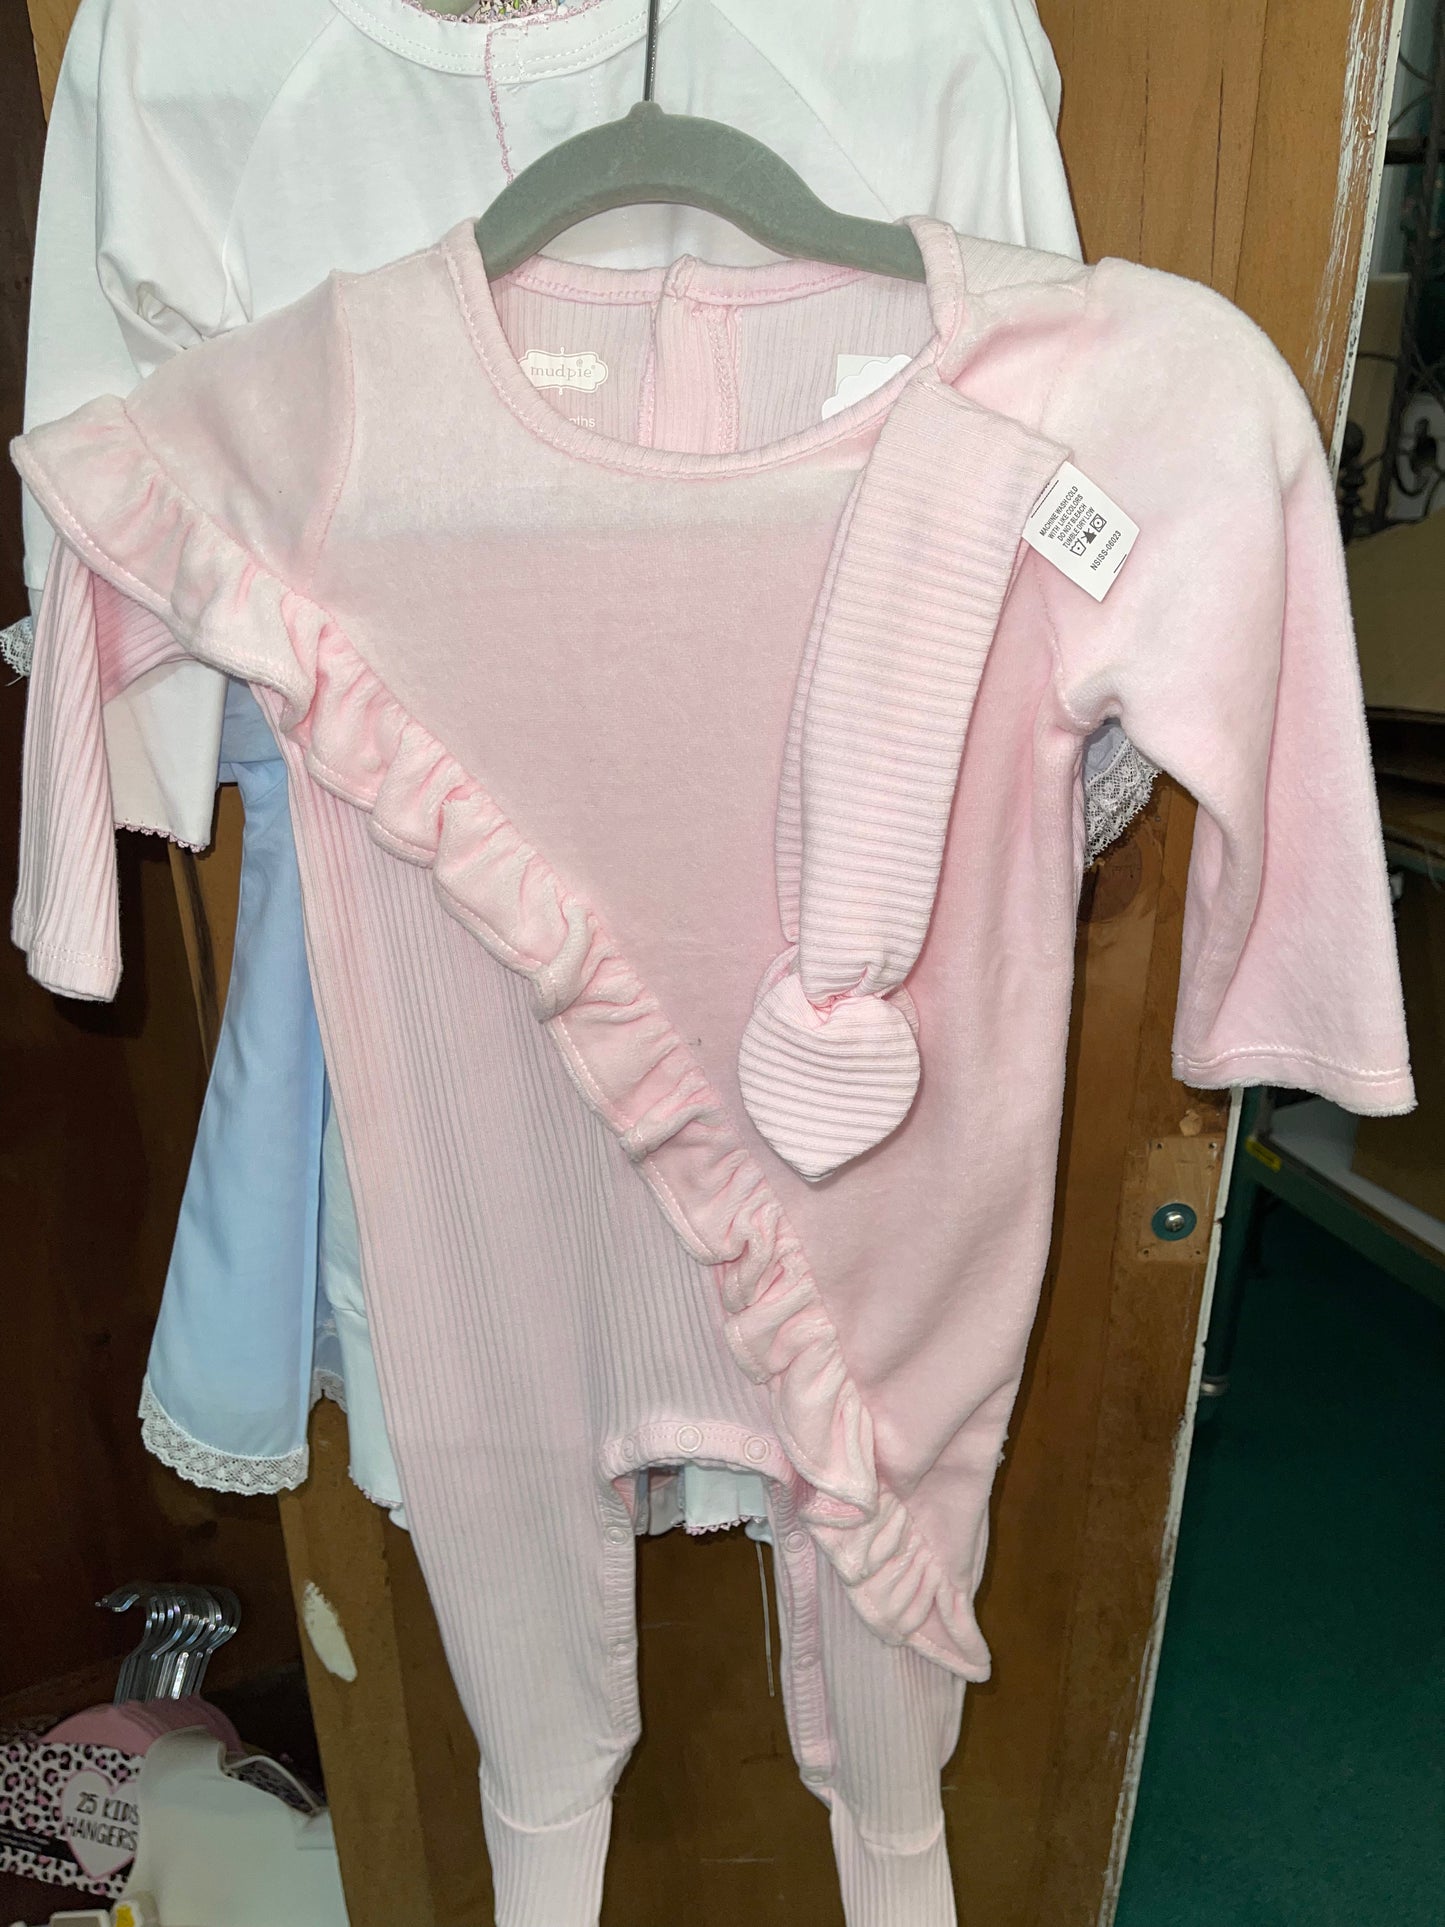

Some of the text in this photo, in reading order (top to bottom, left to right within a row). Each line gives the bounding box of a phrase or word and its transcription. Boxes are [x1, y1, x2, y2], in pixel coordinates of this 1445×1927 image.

[530, 359, 592, 381] mudpie
[1039, 485, 1078, 536] MACHINE WASH COLD
[1048, 494, 1083, 539] WITH LIKE COLORS
[1057, 503, 1087, 541] DO NOT BLEACH
[1062, 506, 1095, 548] TUMBLE DRY LOW
[77, 1791, 139, 1826] 25 KIDS
[66, 1816, 138, 1852] HANGERS
